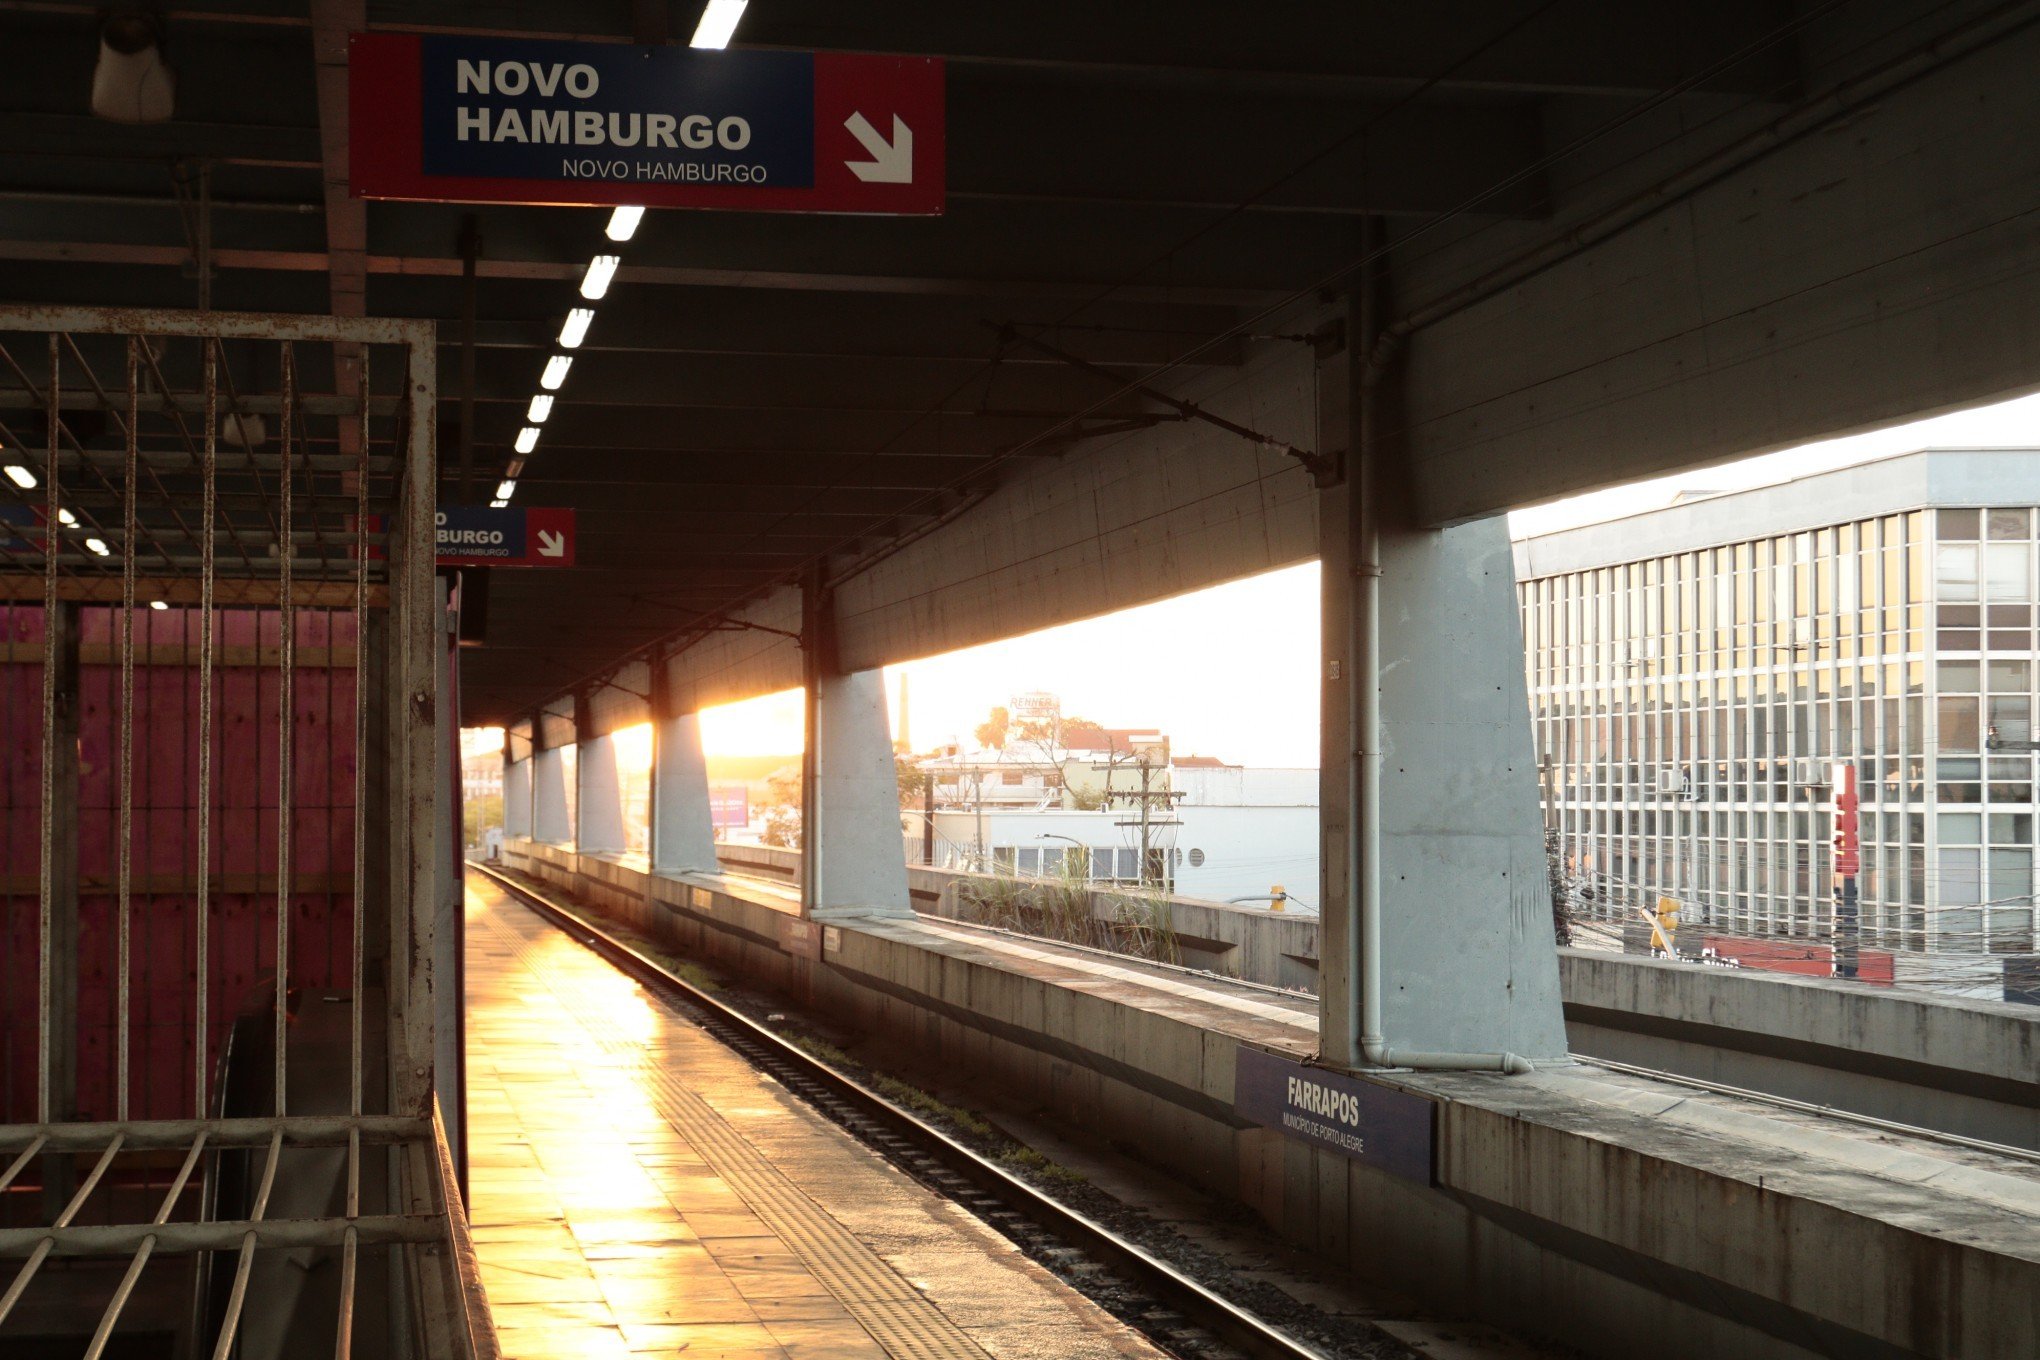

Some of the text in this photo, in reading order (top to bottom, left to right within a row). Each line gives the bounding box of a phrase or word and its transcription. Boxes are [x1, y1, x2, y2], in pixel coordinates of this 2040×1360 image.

[457, 59, 600, 98] NOVO
[457, 106, 751, 151] HAMBURGO
[562, 159, 767, 183] NOVO HAMBURGO
[436, 529, 502, 543] BURGO
[1288, 1076, 1359, 1127] FARRAPOS
[1283, 1111, 1364, 1154] MUNICÍPIO DE PORTO ALEGRE
